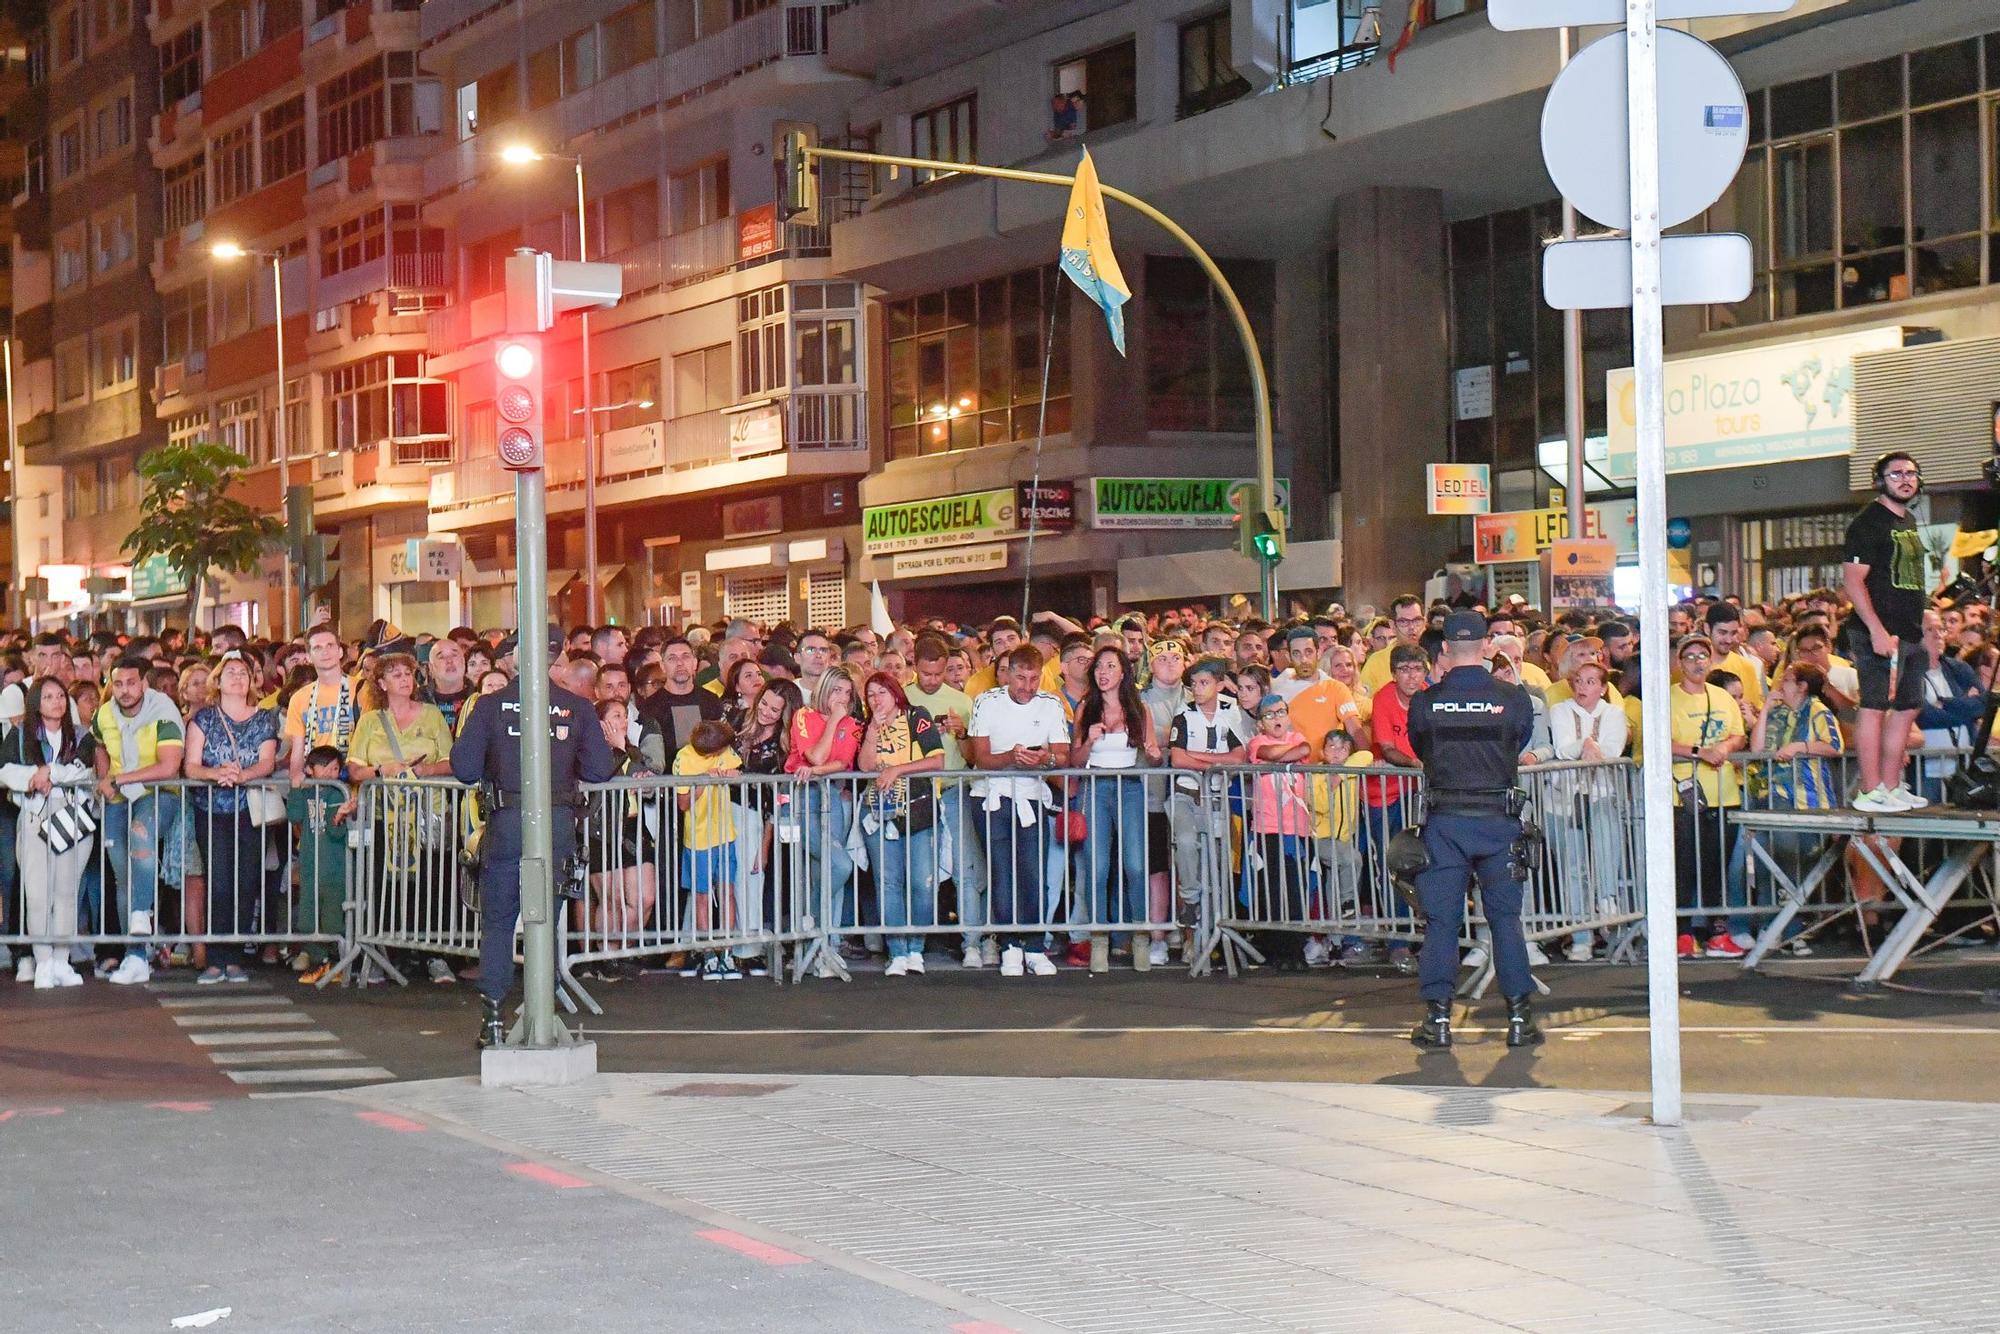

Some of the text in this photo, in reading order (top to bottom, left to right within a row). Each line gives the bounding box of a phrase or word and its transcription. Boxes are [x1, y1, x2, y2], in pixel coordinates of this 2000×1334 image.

[1664, 373, 1761, 416] a Plaza
[1714, 412, 1761, 436] tours
[1099, 483, 1224, 512] AUTOESCUELA
[1436, 479, 1487, 493] LEDTEL
[868, 499, 983, 539] AUTOESCUELA
[1535, 509, 1608, 545] LEDEL
[923, 559, 935, 568] POR
[936, 557, 943, 566] EL
[944, 556, 966, 566] PORTAL
[1432, 702, 1493, 713] POLICIA
